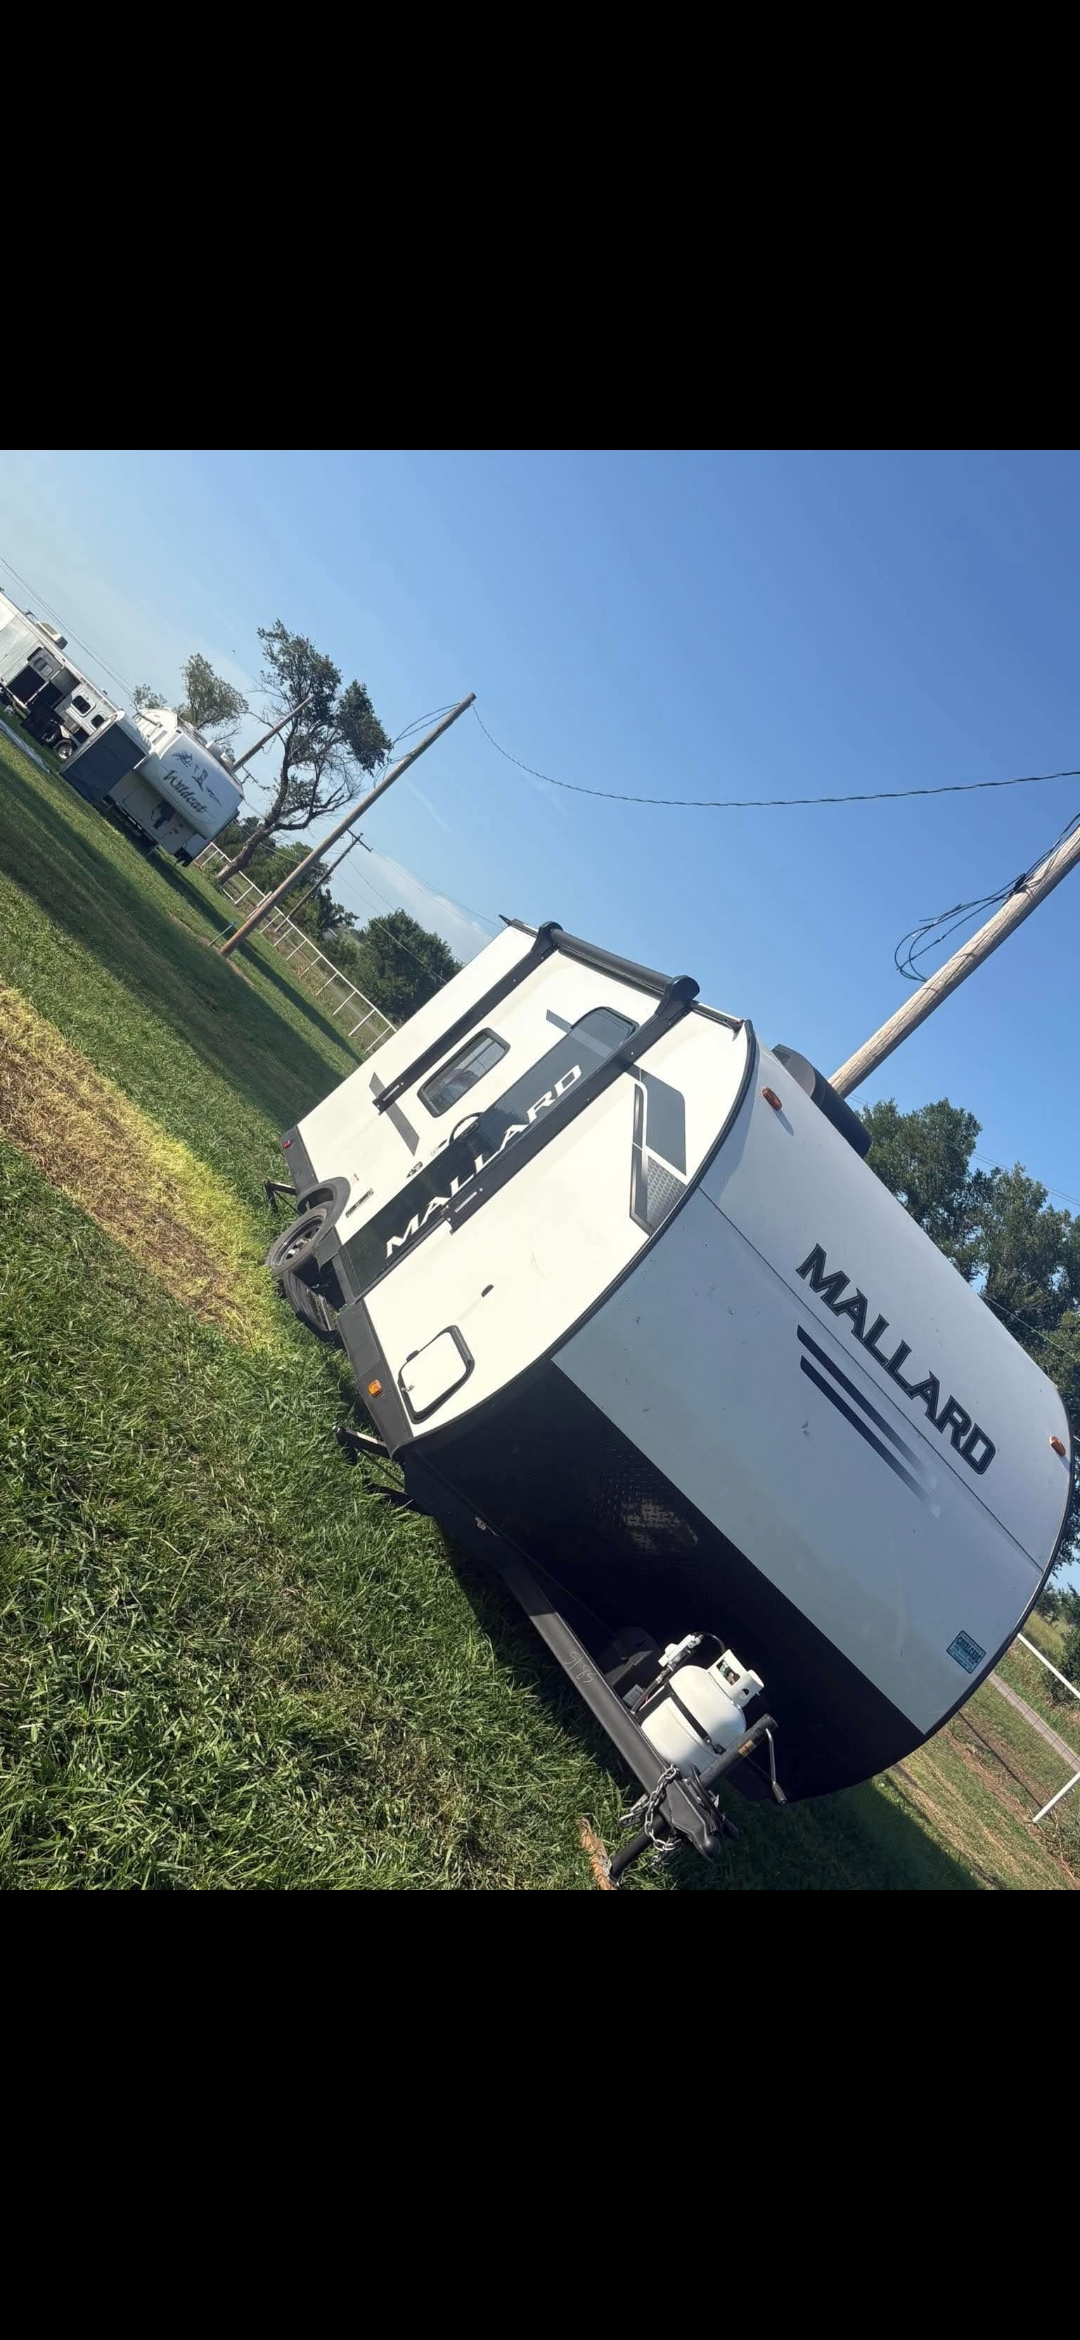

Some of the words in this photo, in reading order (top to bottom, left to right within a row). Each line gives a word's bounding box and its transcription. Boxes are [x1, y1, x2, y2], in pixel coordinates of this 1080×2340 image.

[163, 769, 208, 814] Wildcat
[386, 1064, 582, 1259] MALLARD
[795, 1243, 996, 1475] MALLARD
